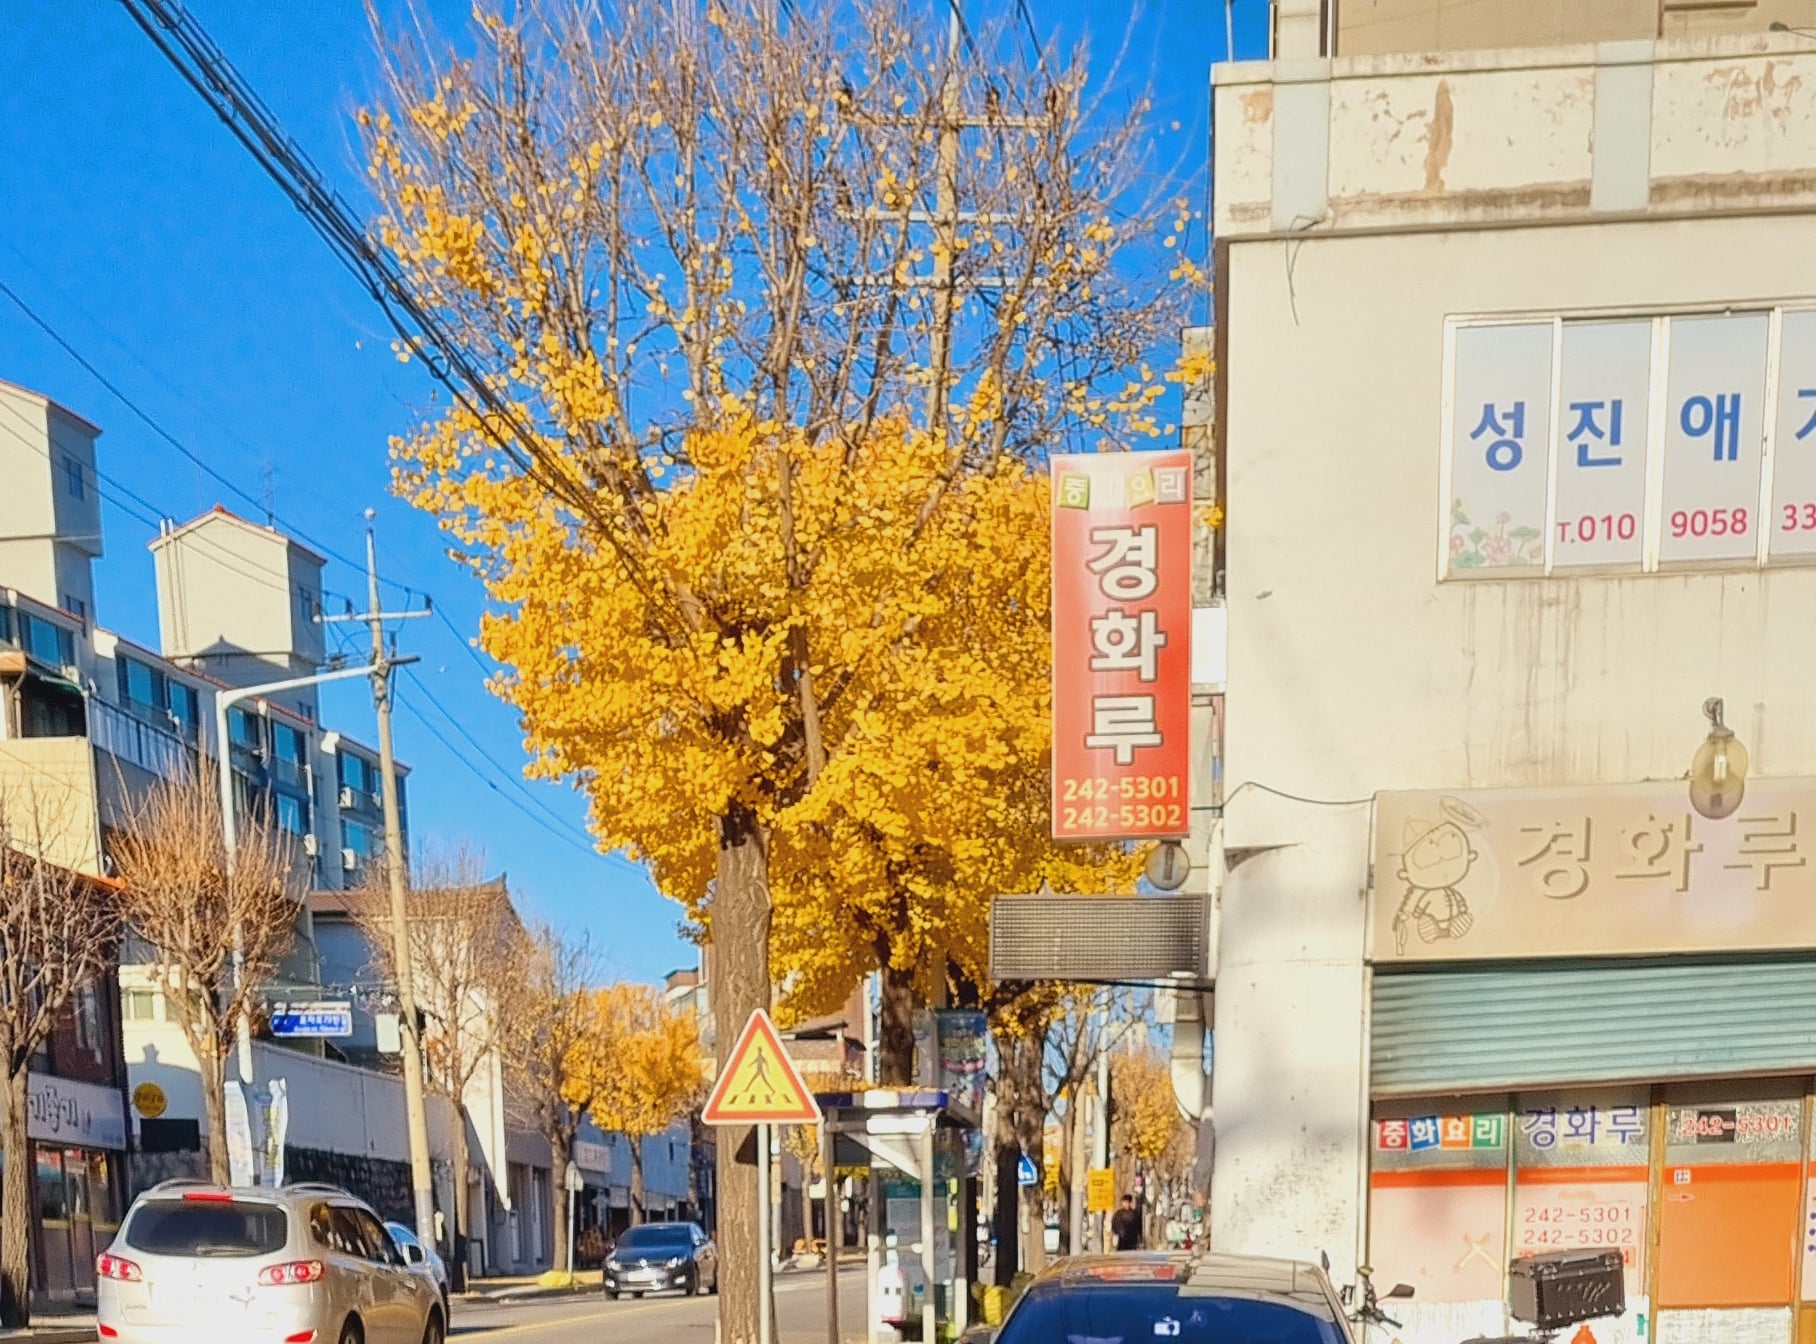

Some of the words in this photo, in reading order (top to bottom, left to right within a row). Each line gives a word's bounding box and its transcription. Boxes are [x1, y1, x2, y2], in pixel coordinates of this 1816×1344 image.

[1062, 470, 1184, 507] 중요리
[1556, 513, 1636, 544] T.010
[1670, 507, 1748, 538] 9058
[1084, 523, 1168, 766] 경화루
[1062, 775, 1179, 802] 242-5301
[1062, 803, 1182, 830] 242-5302
[1517, 811, 1808, 901] 경화루
[1379, 1114, 1502, 1150] 중화요리
[1522, 1104, 1645, 1148] 경화루
[1680, 1114, 1792, 1138] 242-5301
[1524, 1206, 1632, 1224] 242-5301
[1523, 1227, 1634, 1245] 242-5302
